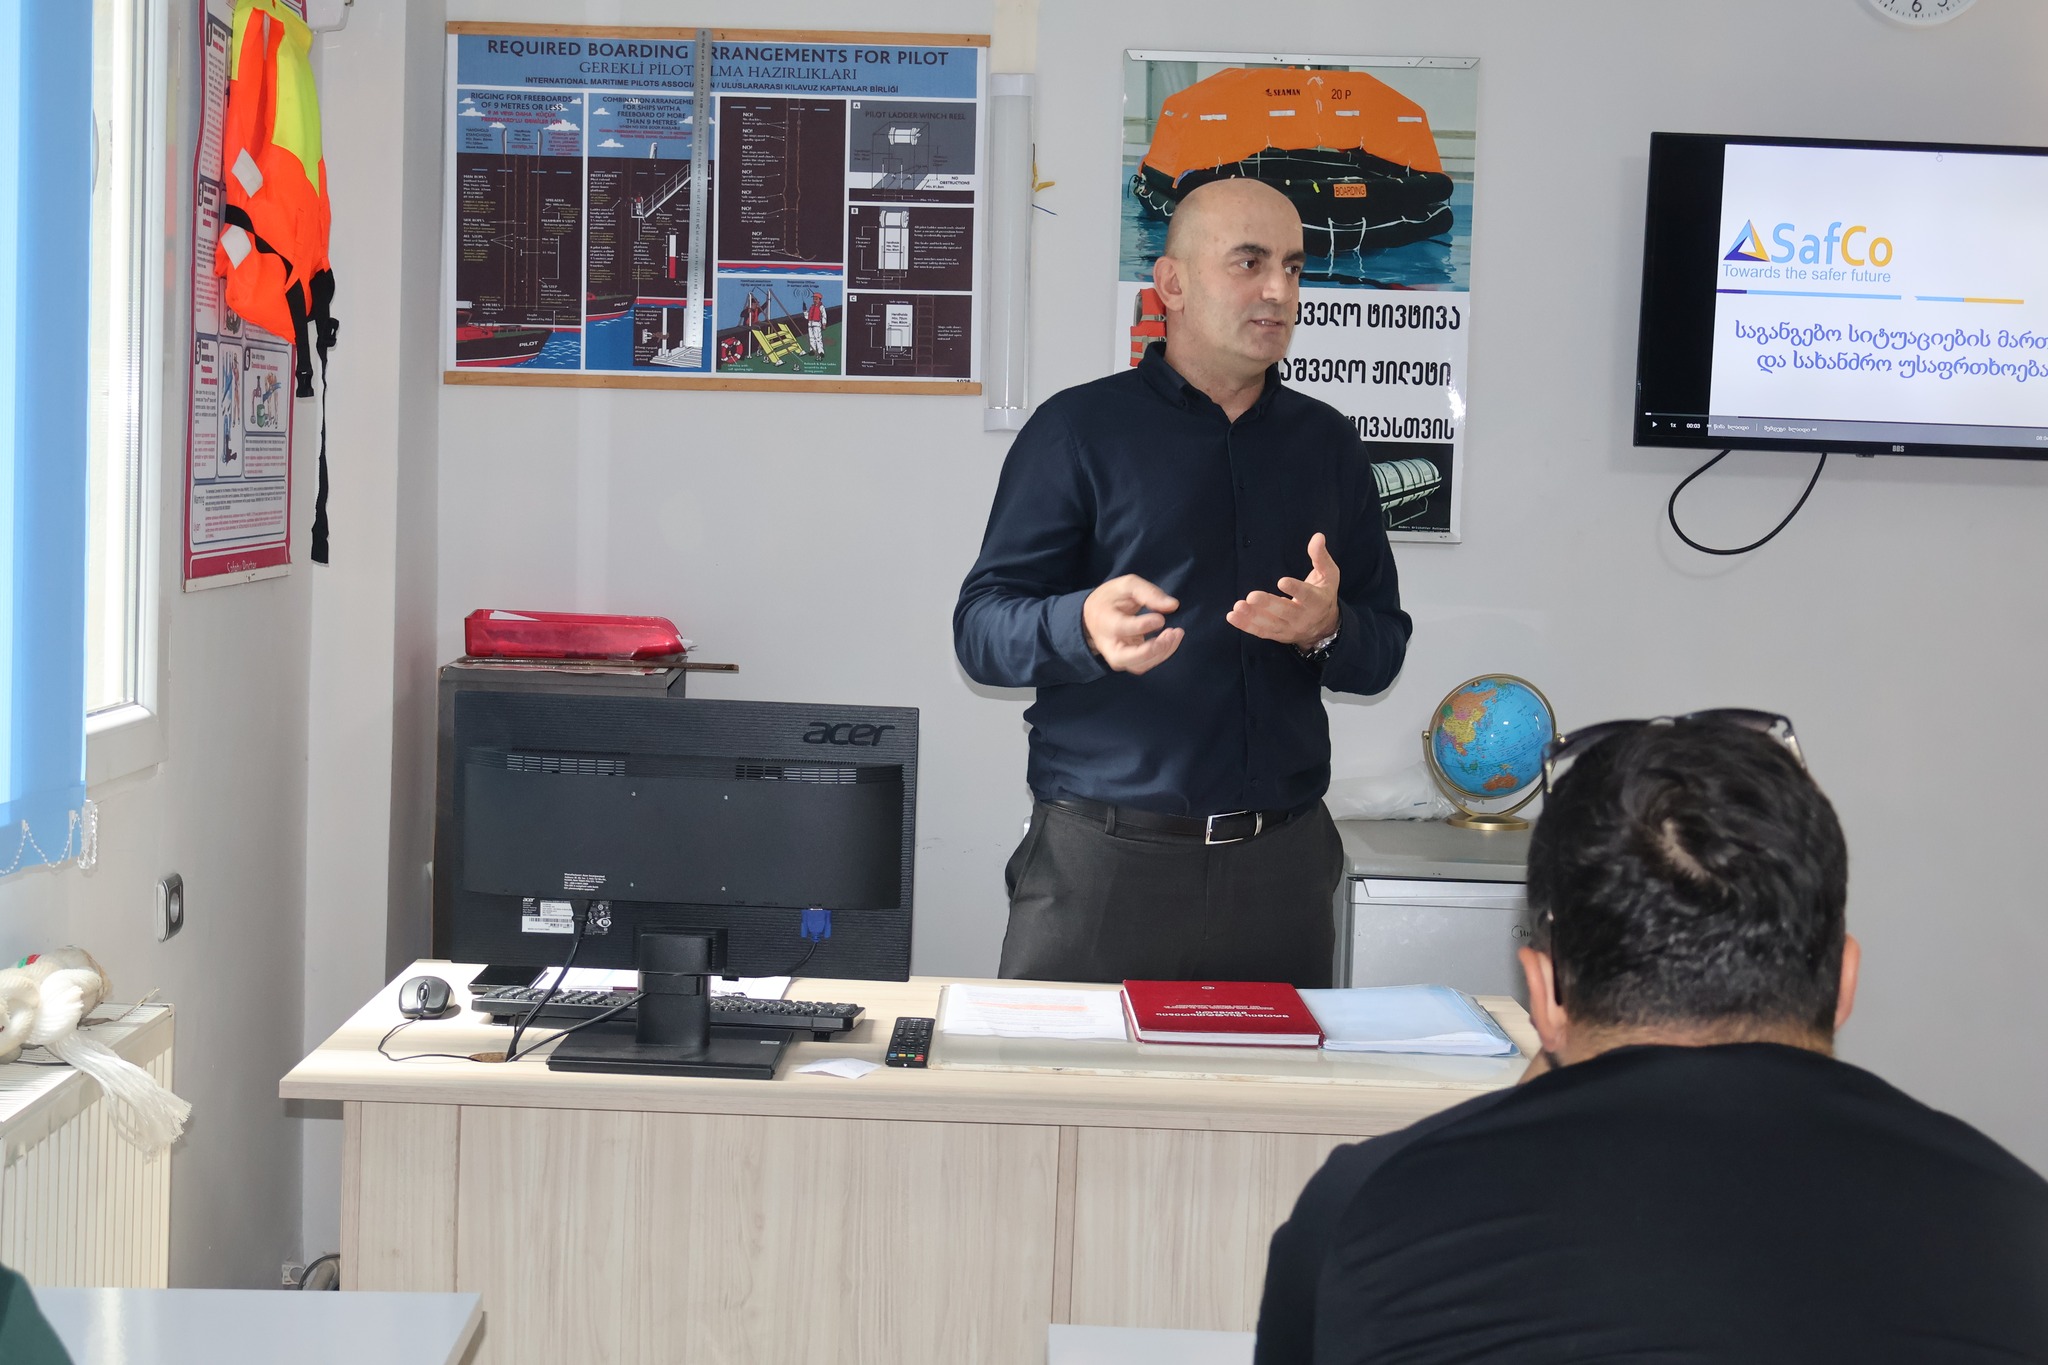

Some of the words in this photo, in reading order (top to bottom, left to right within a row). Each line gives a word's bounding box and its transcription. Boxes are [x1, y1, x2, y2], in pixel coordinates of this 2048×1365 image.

[487, 40, 581, 56] REQUIRED
[588, 43, 689, 59] BOARDING
[712, 46, 848, 64] RRANGEMENTS
[854, 50, 890, 64] FOR
[898, 50, 949, 66] PILOT
[580, 60, 644, 75] GEREKLİ
[649, 62, 694, 76] PİLOT
[711, 65, 744, 78] LMA
[748, 66, 857, 80] HAZIRLIKLARI
[525, 76, 588, 85] INTERNATIONAL
[590, 78, 629, 86] MARITIME
[721, 82, 783, 90] ULUSLARARASI
[785, 83, 818, 91] KILAVUZ
[820, 84, 868, 92] KAPTANLAR
[870, 84, 899, 94] BİRLİĞİ
[1332, 88, 1342, 100] 20
[1345, 90, 1351, 100] P
[470, 92, 504, 100] RIGGING
[524, 94, 572, 102] FREEBOARDS
[602, 96, 650, 104] COMBINATION
[651, 97, 694, 105] ARRANGEME
[1335, 186, 1364, 196] BOARDING
[1770, 221, 1893, 268] SafCo
[1722, 263, 1781, 280] Towards
[1786, 266, 1806, 279] the
[1811, 267, 1846, 281] safer
[1851, 269, 1891, 283] future
[1368, 304, 1460, 330] ტივტივა
[1735, 320, 1842, 346] საგანგებო
[1849, 324, 1991, 352] სიტუაციების
[1372, 361, 1451, 386] ჟილეტი
[1757, 354, 1786, 374] და
[1793, 350, 1892, 372] სახანძრო
[1346, 416, 1454, 439] ივასთვის
[802, 722, 895, 746] acer
